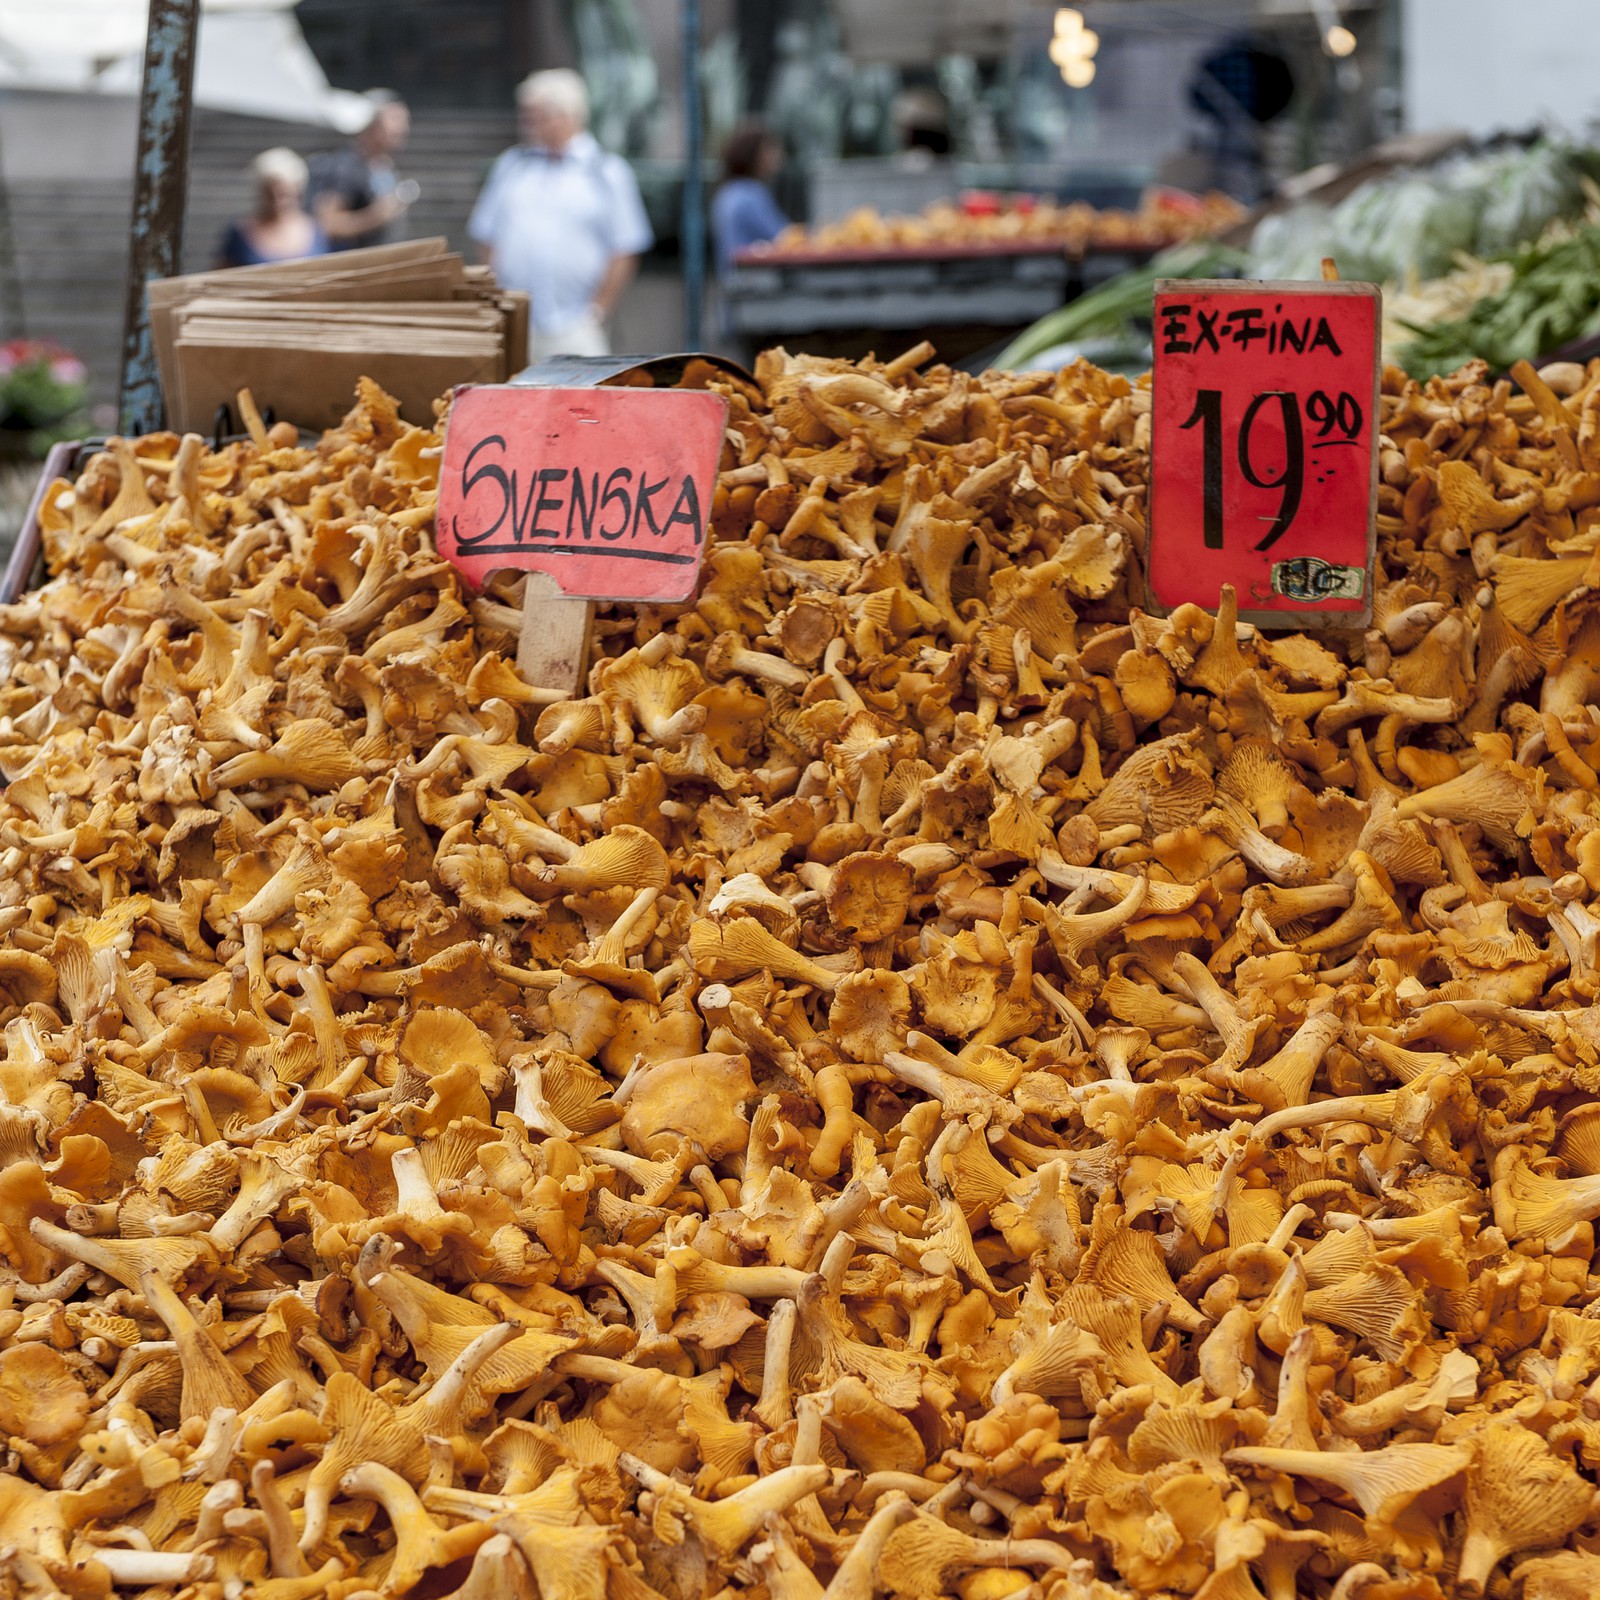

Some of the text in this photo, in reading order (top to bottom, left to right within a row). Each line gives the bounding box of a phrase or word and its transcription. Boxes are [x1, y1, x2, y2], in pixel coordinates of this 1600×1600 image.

[453, 434, 702, 546] SVENSKA
[1179, 388, 1363, 552] 19 90
